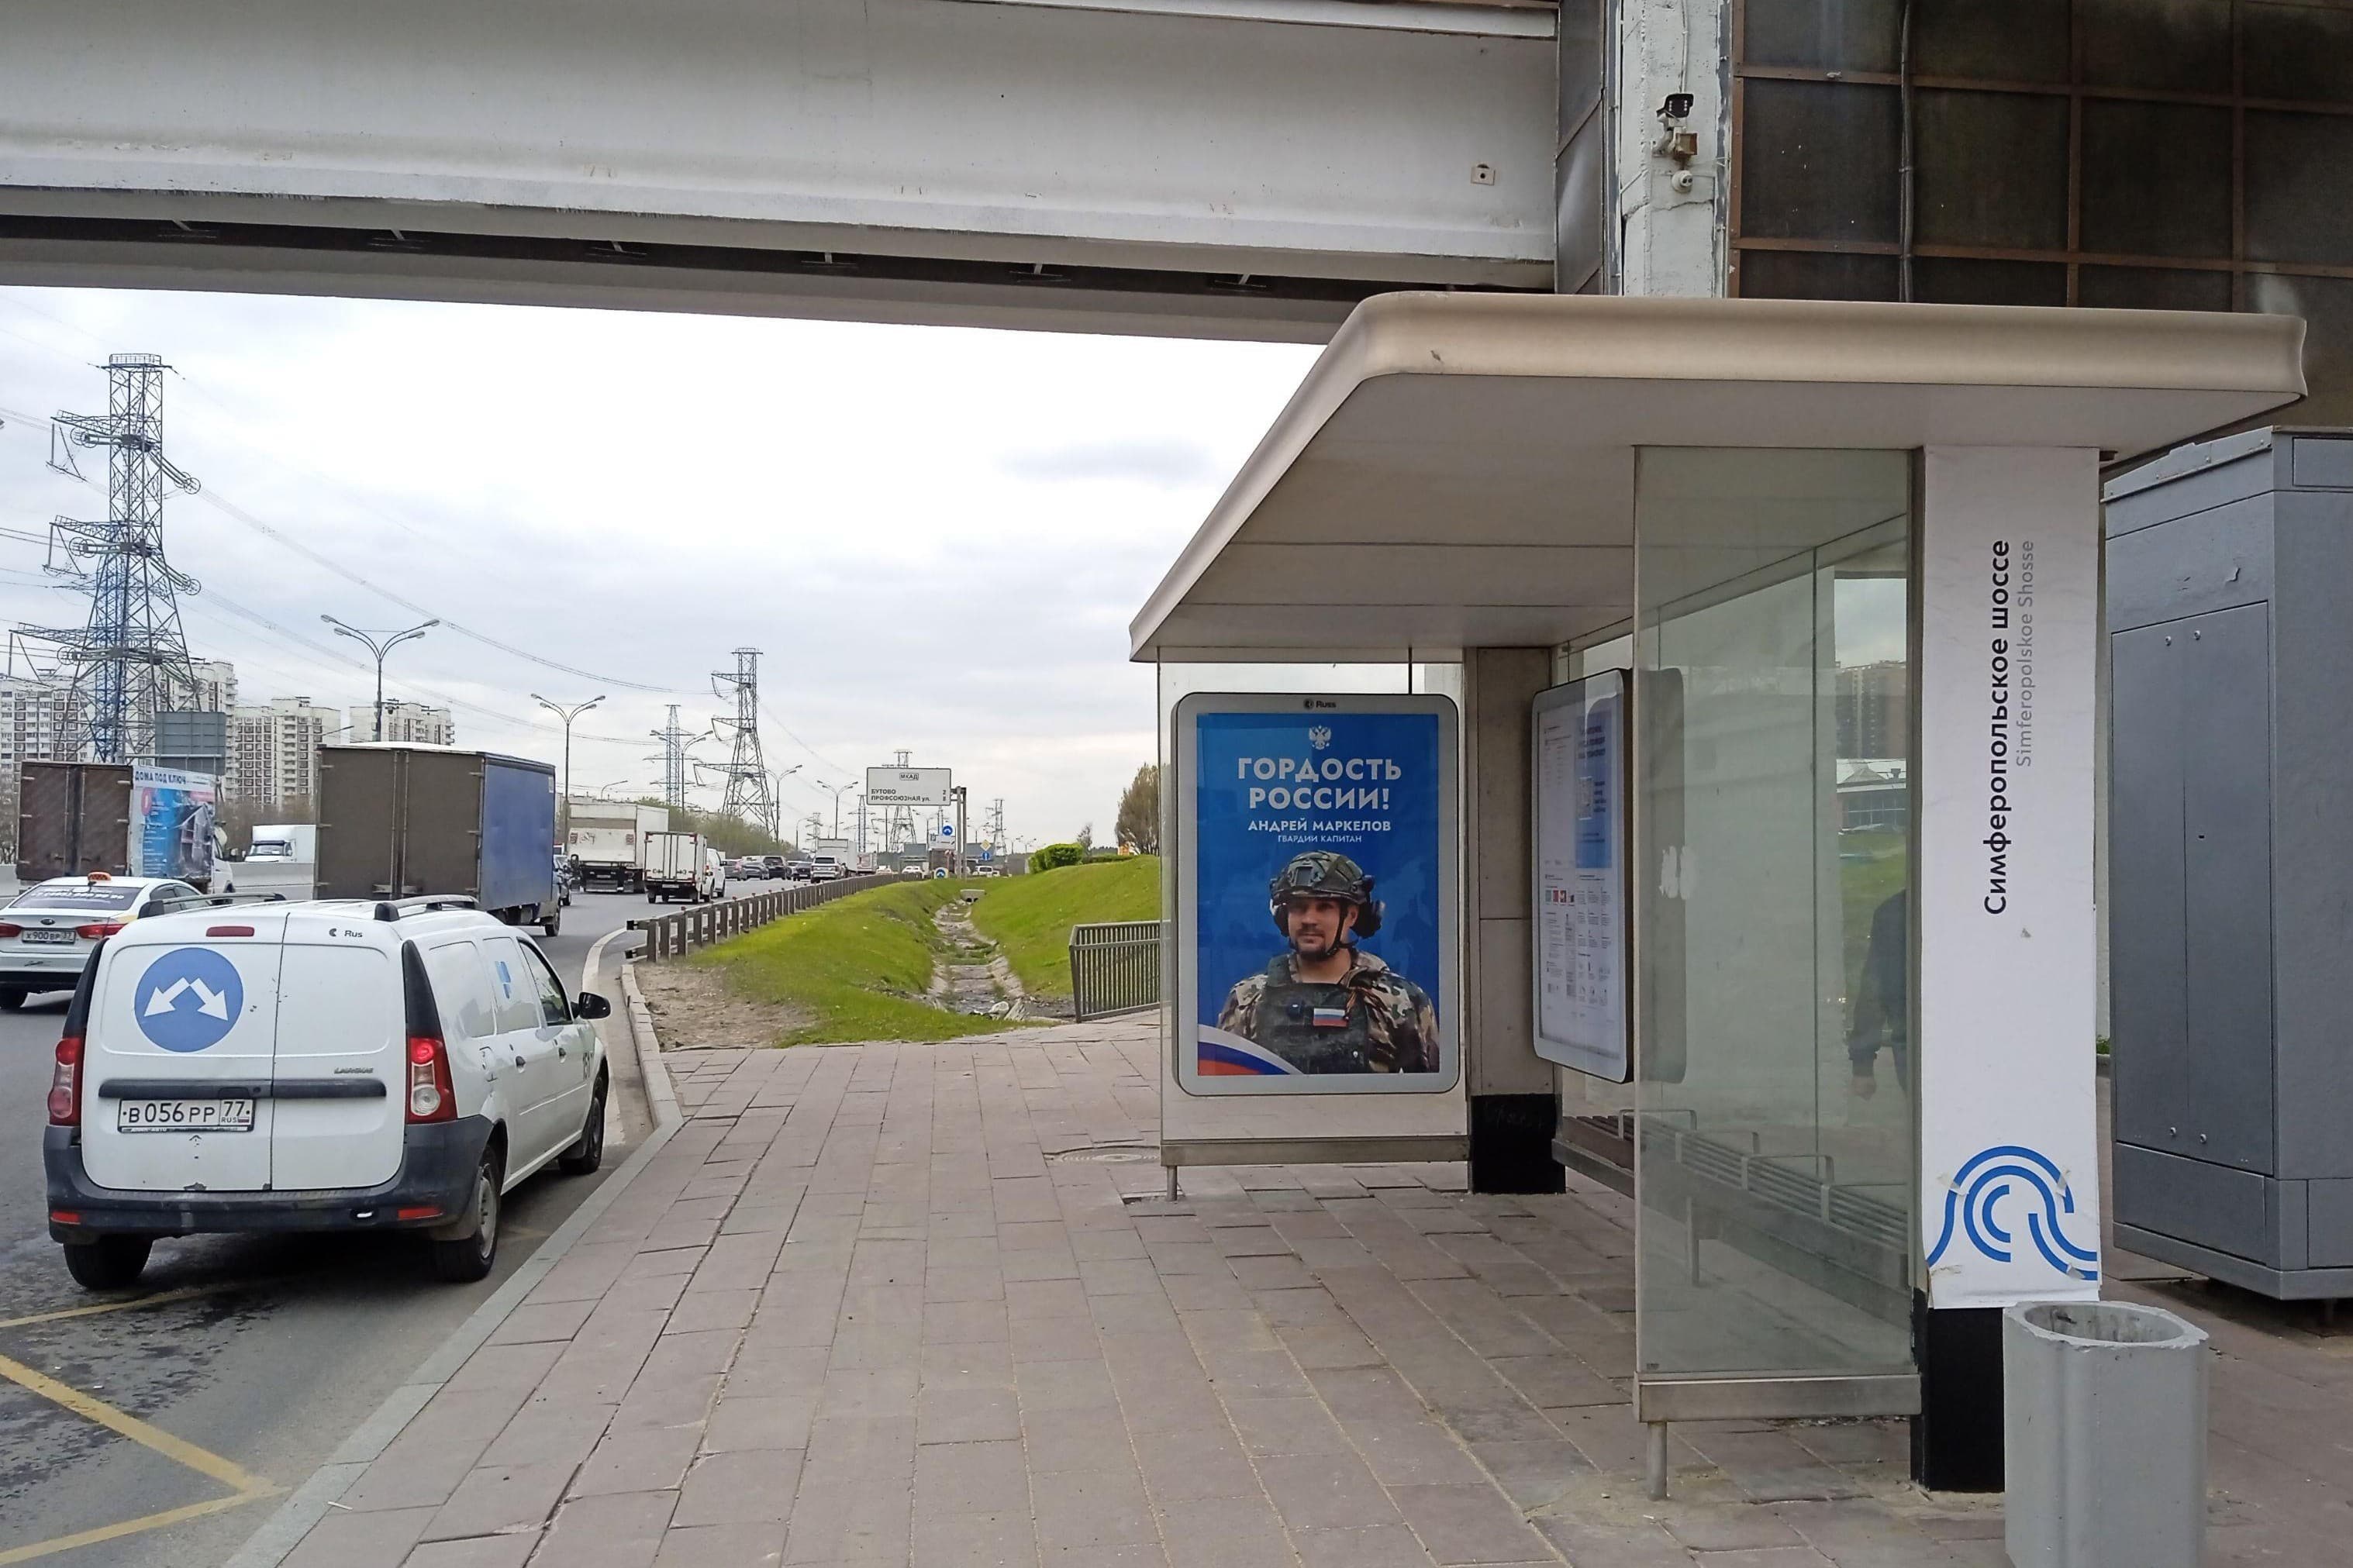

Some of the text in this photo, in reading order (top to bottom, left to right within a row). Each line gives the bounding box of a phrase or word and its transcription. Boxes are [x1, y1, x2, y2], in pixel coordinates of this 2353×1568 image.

[2016, 540, 2036, 767] Simferopolskoe Shosse
[1982, 540, 2013, 915] Симферопольское шоссе
[135, 770, 154, 782] ДОМА
[155, 772, 167, 784] ПОД
[1238, 757, 1402, 783] ГОРДОСТЬ
[1249, 787, 1389, 810] РОССИИ!
[1247, 818, 1392, 832] АНДРЕЙ МАРКЕЛОВ
[1278, 834, 1362, 843] ГВАРДИИ КАПИТАН
